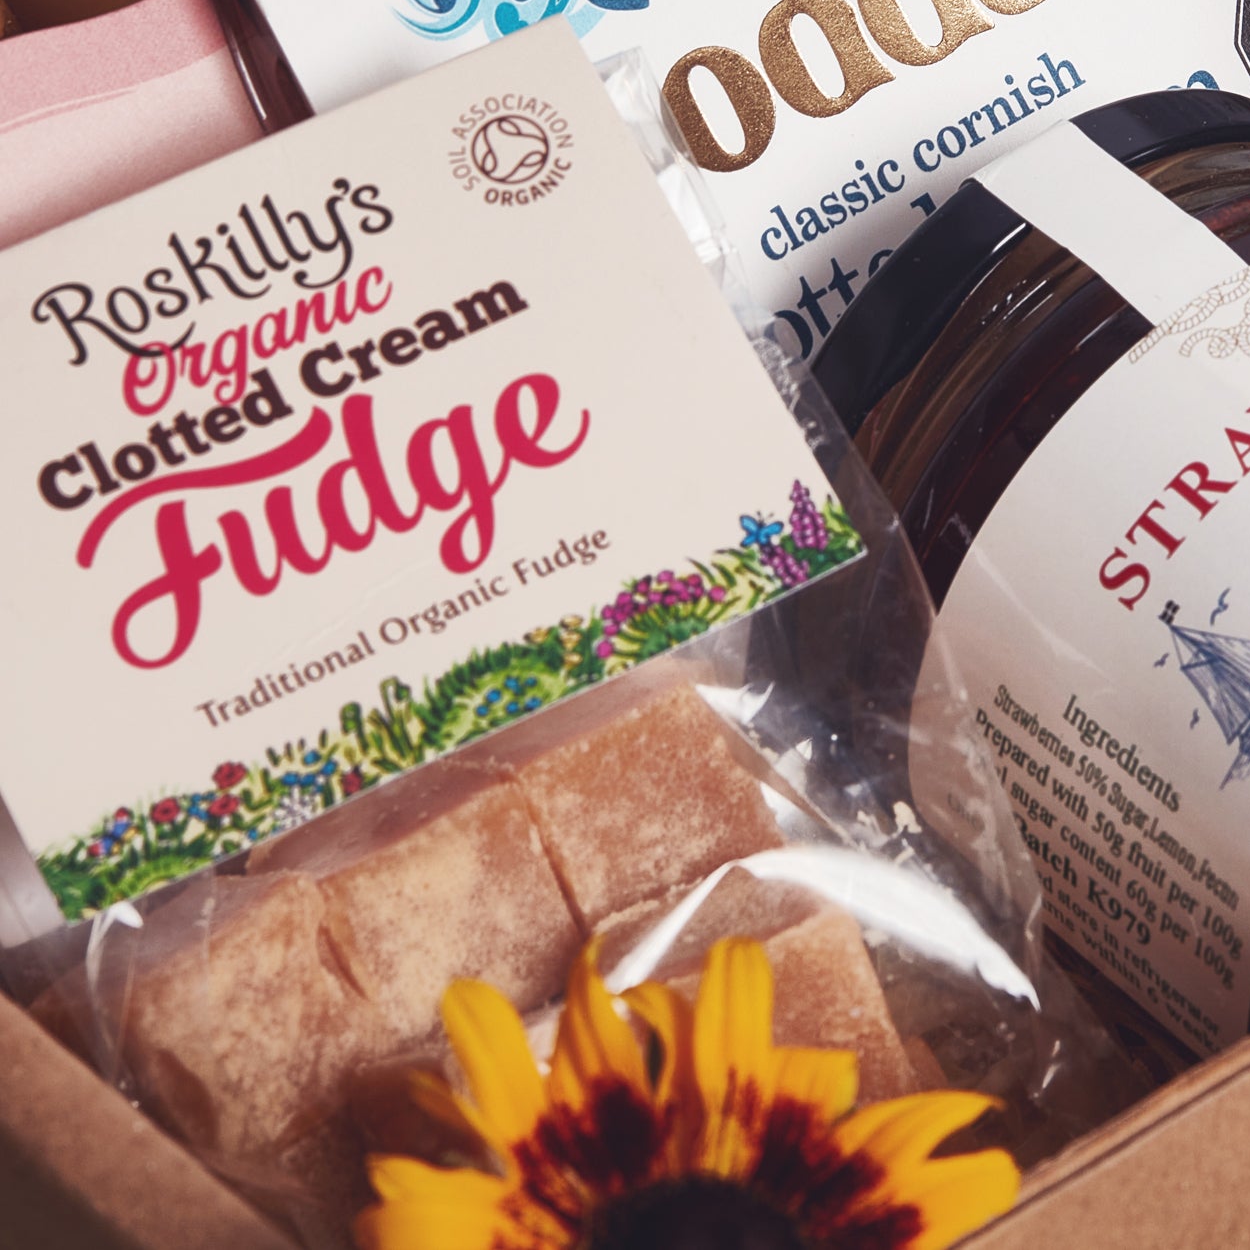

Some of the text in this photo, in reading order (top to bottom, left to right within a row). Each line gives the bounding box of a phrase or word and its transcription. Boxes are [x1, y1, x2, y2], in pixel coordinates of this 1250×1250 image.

[447, 92, 575, 192] SOIL ASSOCIATION
[483, 156, 573, 207] ORGANIC
[759, 51, 1087, 262] classic cornish
[31, 177, 394, 367] Roskilly's
[121, 264, 393, 417] Organic
[36, 279, 529, 511] Clotted Cream
[75, 372, 591, 671] Fudge
[195, 528, 612, 729] Traditional Organic Fudge
[975, 707, 1244, 961] Prepared with 50g fruit per 100g
[993, 683, 1076, 769] Strawberries
[1074, 753, 1110, 797] 50%
[1062, 693, 1183, 814] Ingredients
[1010, 780, 1058, 830] sugar
[1059, 824, 1124, 887] content
[1125, 879, 1158, 923] 60g
[1159, 911, 1191, 944] per
[1195, 936, 1236, 991] 100g
[1087, 875, 1152, 946] K979
